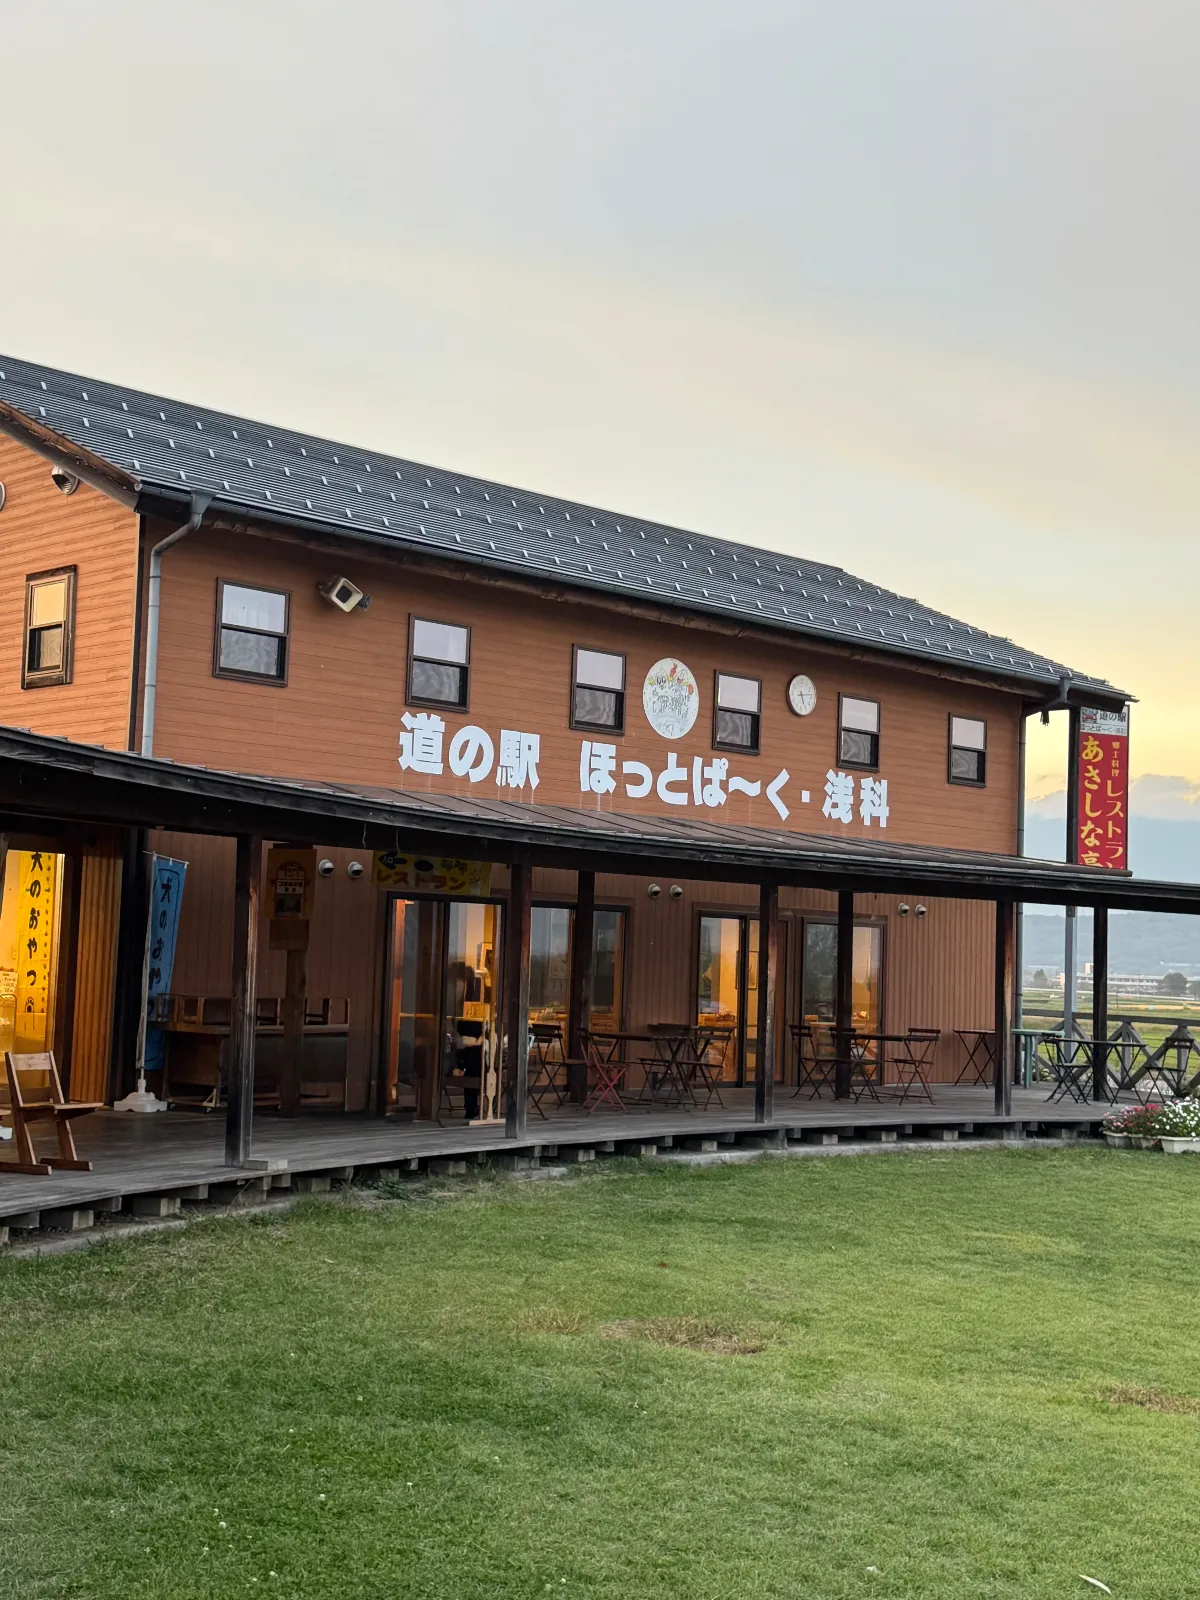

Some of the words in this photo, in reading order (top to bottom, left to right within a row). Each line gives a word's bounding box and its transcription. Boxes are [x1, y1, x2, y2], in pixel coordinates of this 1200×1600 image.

[398, 710, 541, 791] 道の駅
[376, 869, 467, 891] レストラン
